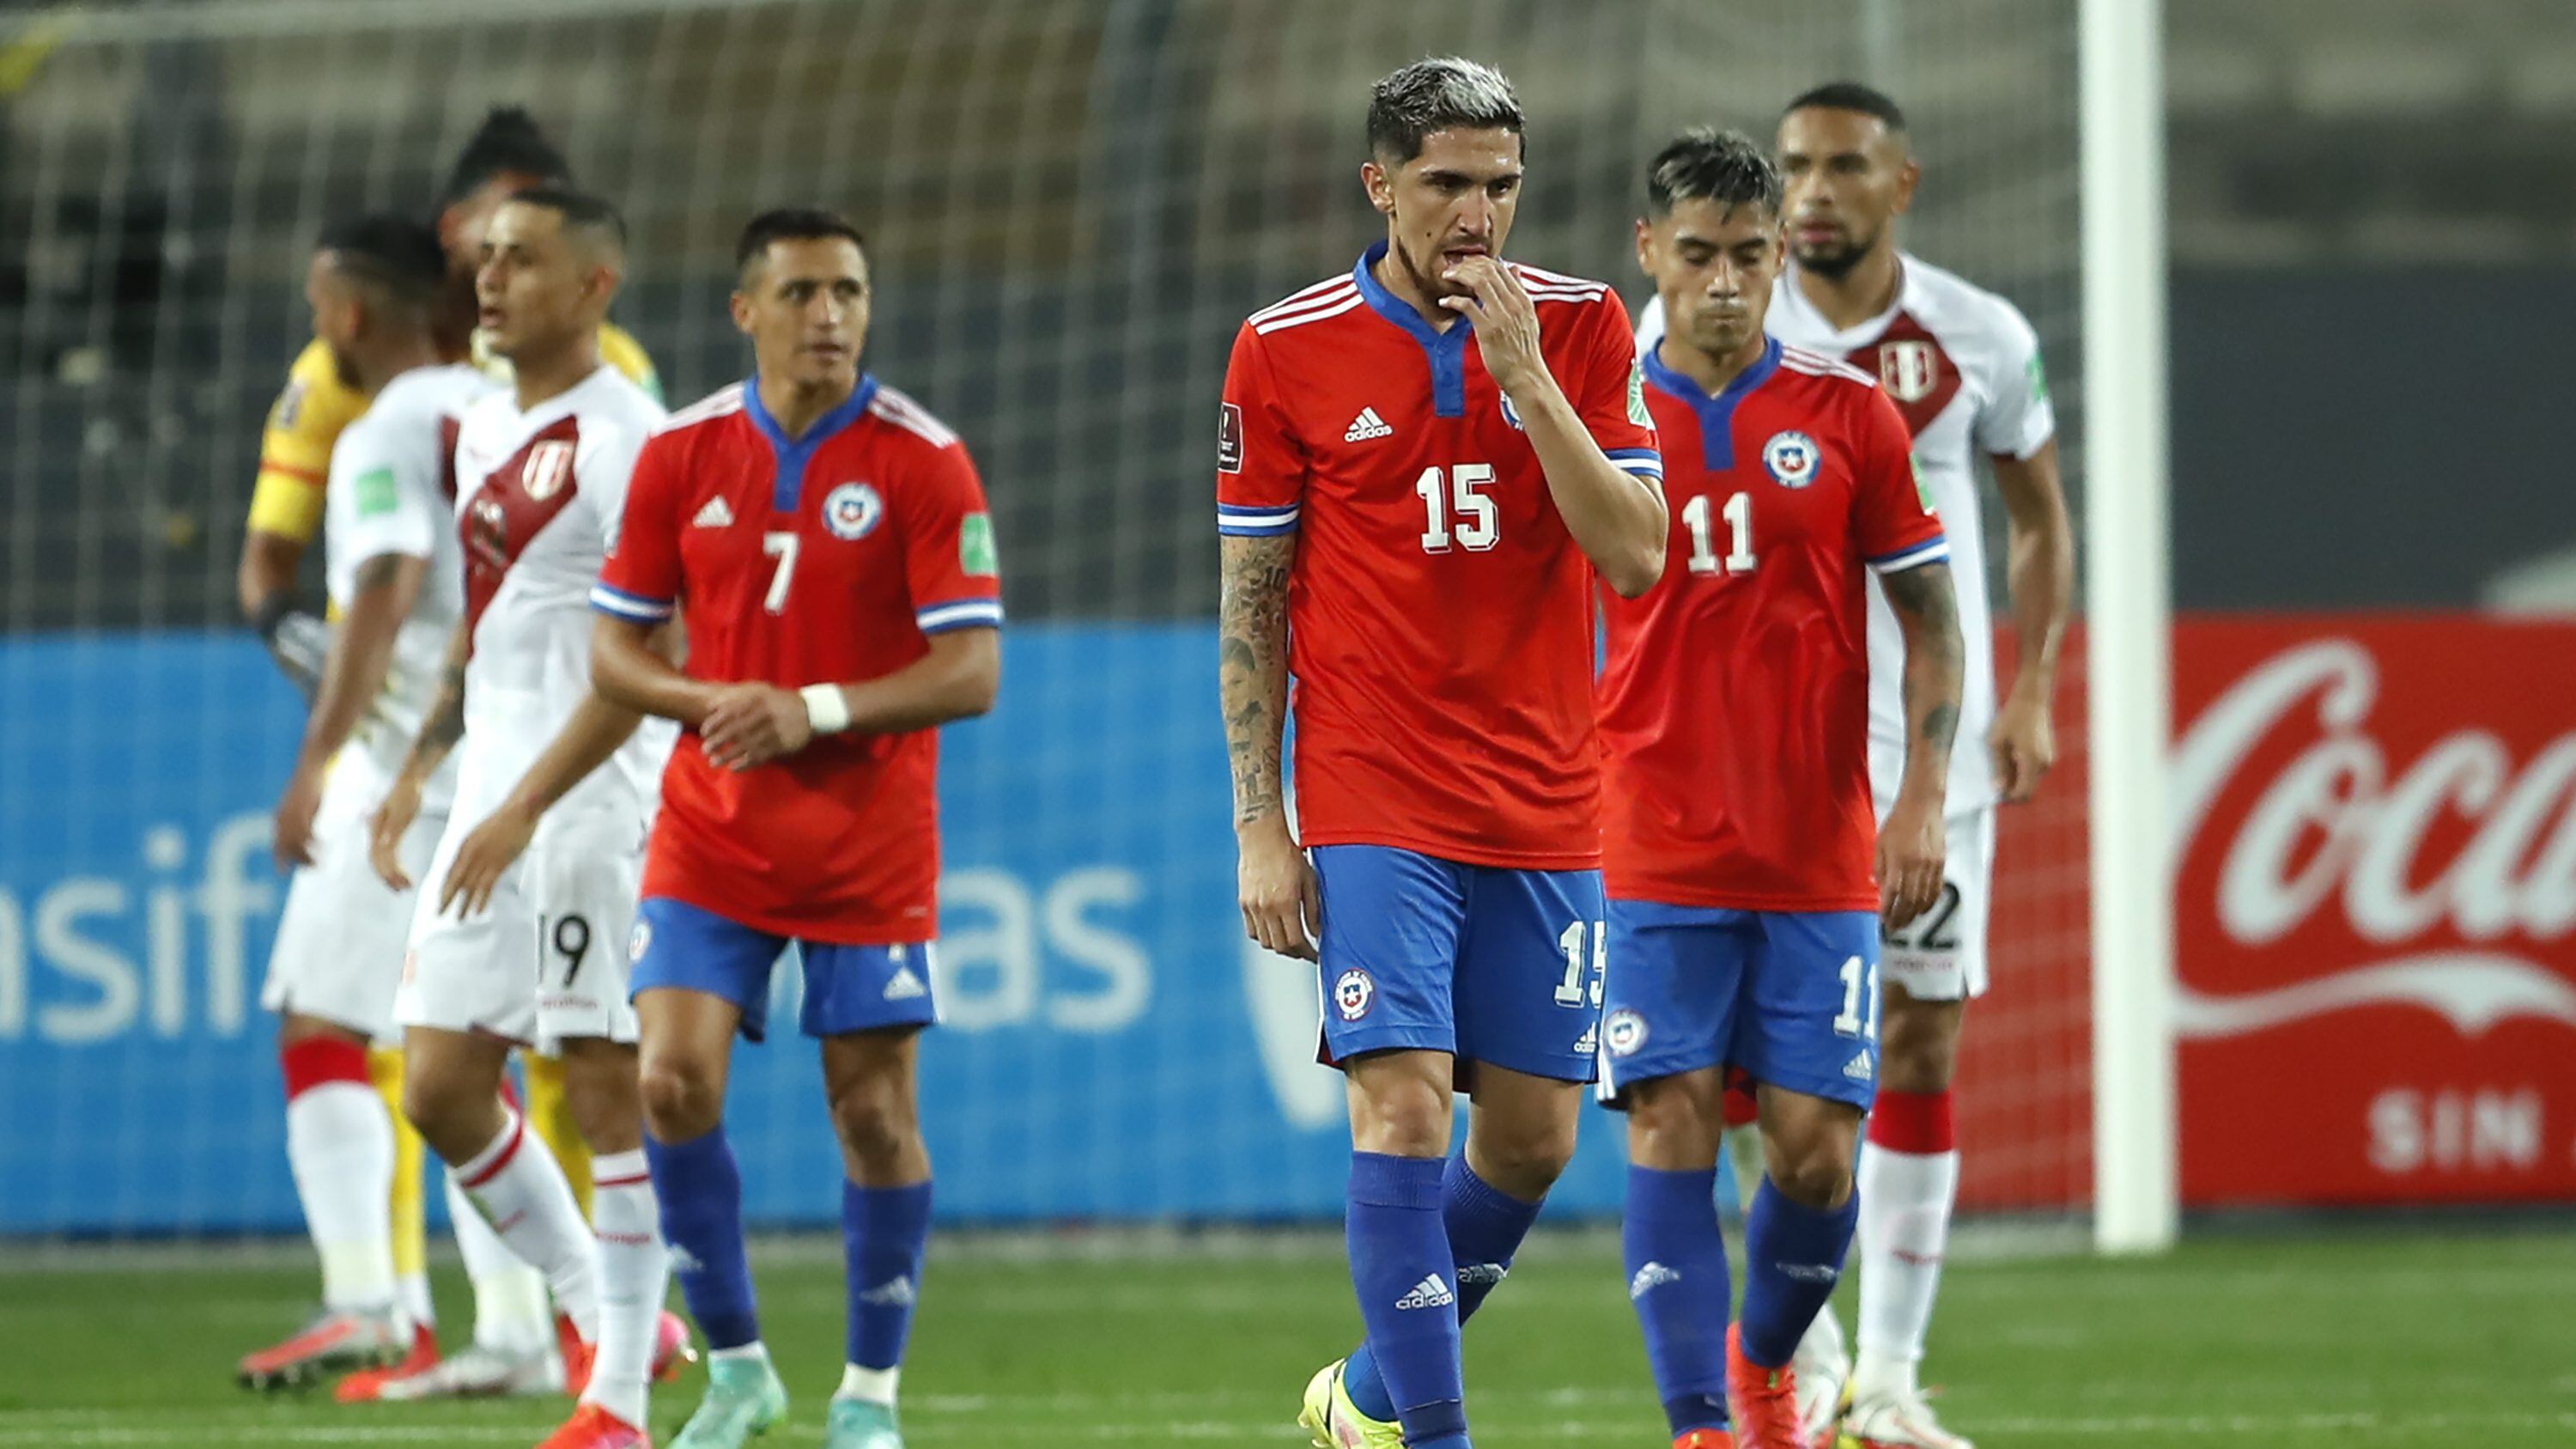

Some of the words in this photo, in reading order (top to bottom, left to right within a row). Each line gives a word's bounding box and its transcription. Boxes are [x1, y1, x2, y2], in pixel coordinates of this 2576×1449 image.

[1344, 424, 1392, 442] adidas
[1416, 463, 1500, 554] 15
[1681, 490, 1758, 576] 11
[762, 530, 800, 616] 7
[0, 813, 275, 1041] sif
[538, 912, 590, 989] 19
[2366, 1087, 2543, 1173] SIN
